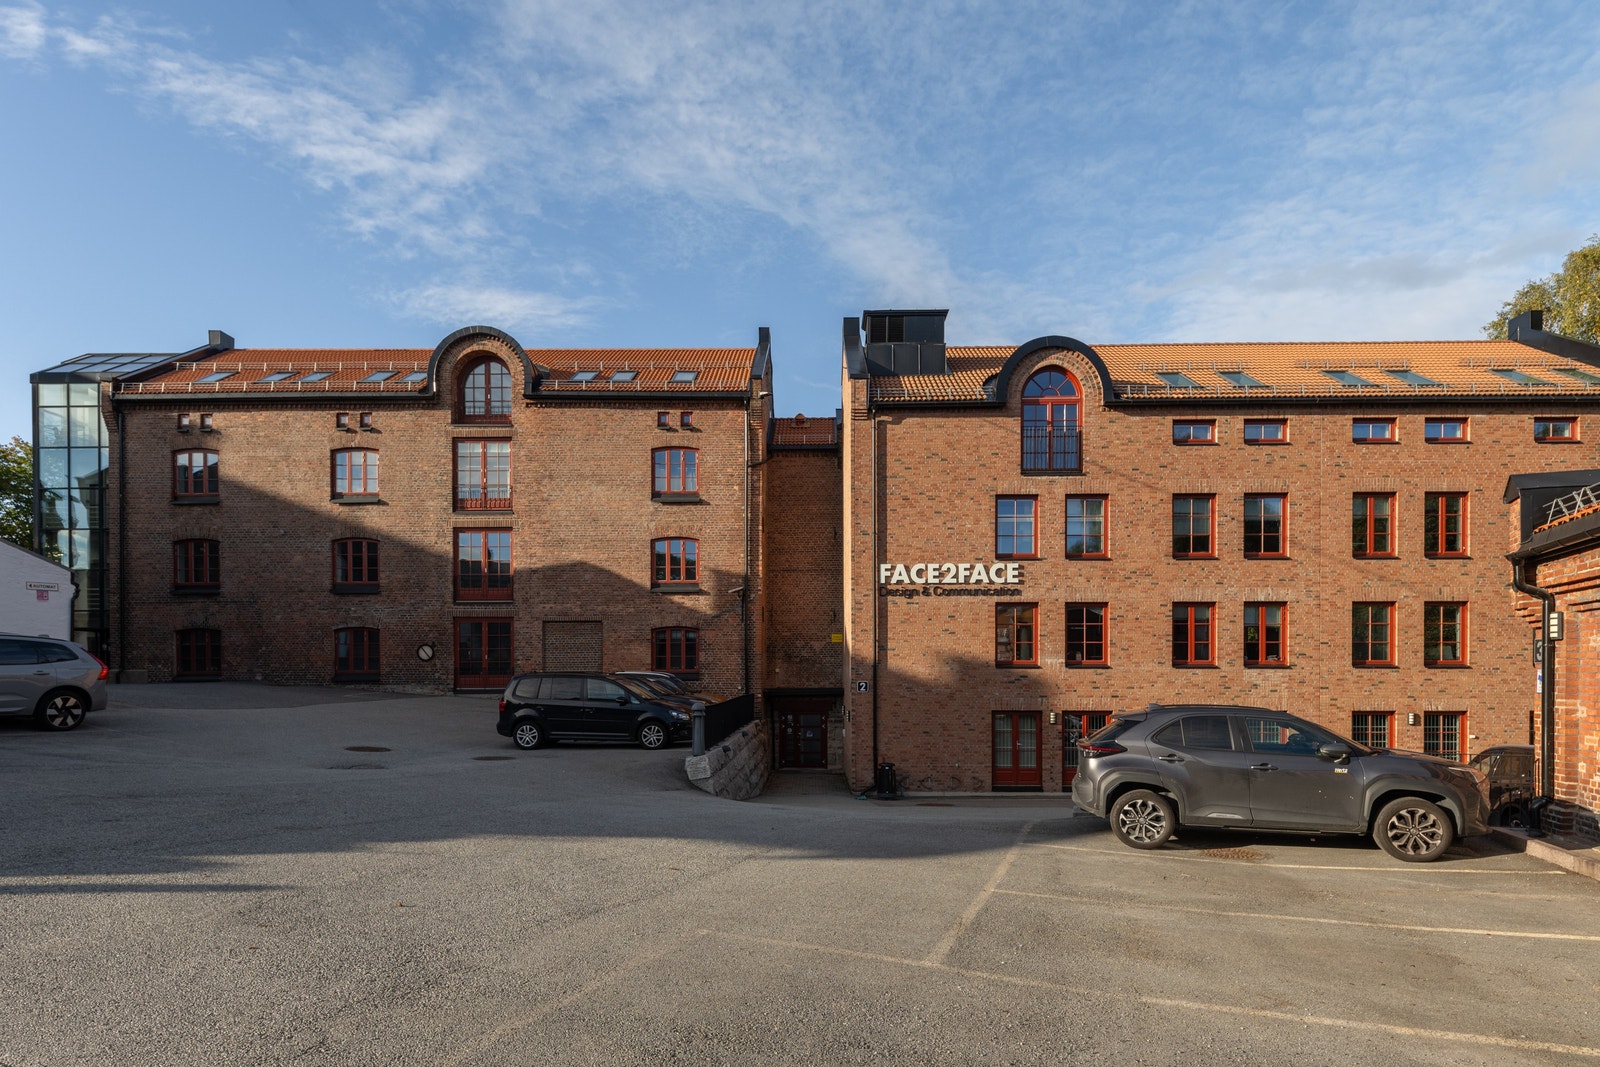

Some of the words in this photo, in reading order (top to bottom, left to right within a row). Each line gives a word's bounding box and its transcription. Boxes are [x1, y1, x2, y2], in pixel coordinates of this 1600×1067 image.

[880, 562, 1019, 584] FACE2FACE
[879, 586, 918, 599] Design
[921, 586, 931, 597] &
[933, 586, 1021, 597] Communication
[860, 682, 866, 691] 2
